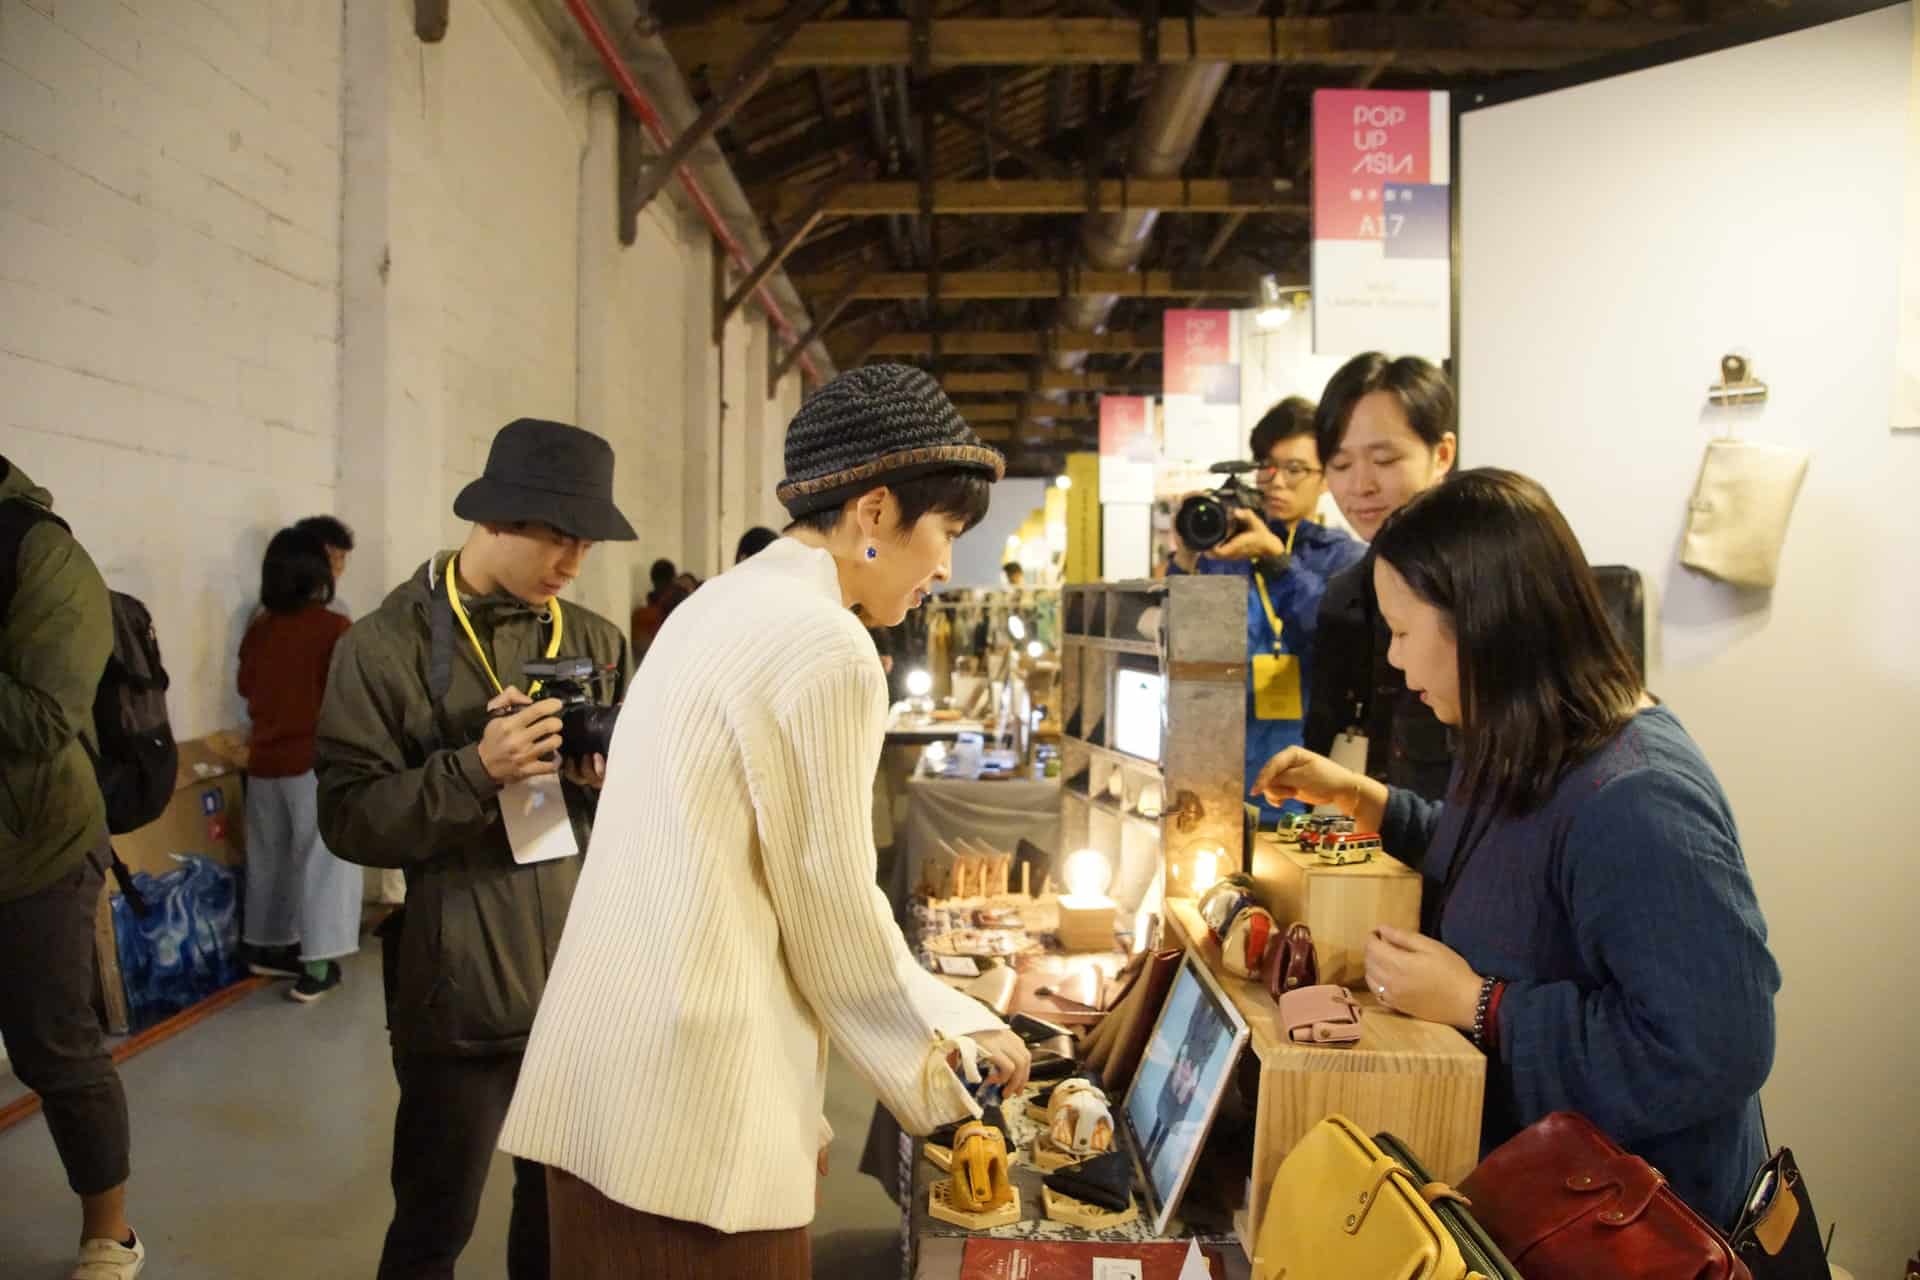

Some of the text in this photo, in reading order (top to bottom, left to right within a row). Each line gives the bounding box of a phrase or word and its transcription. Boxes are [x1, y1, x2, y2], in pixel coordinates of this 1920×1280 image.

[1354, 106, 1405, 127] POP
[1355, 131, 1387, 151] UP
[1353, 154, 1412, 175] ASIA
[1360, 215, 1405, 237] A17
